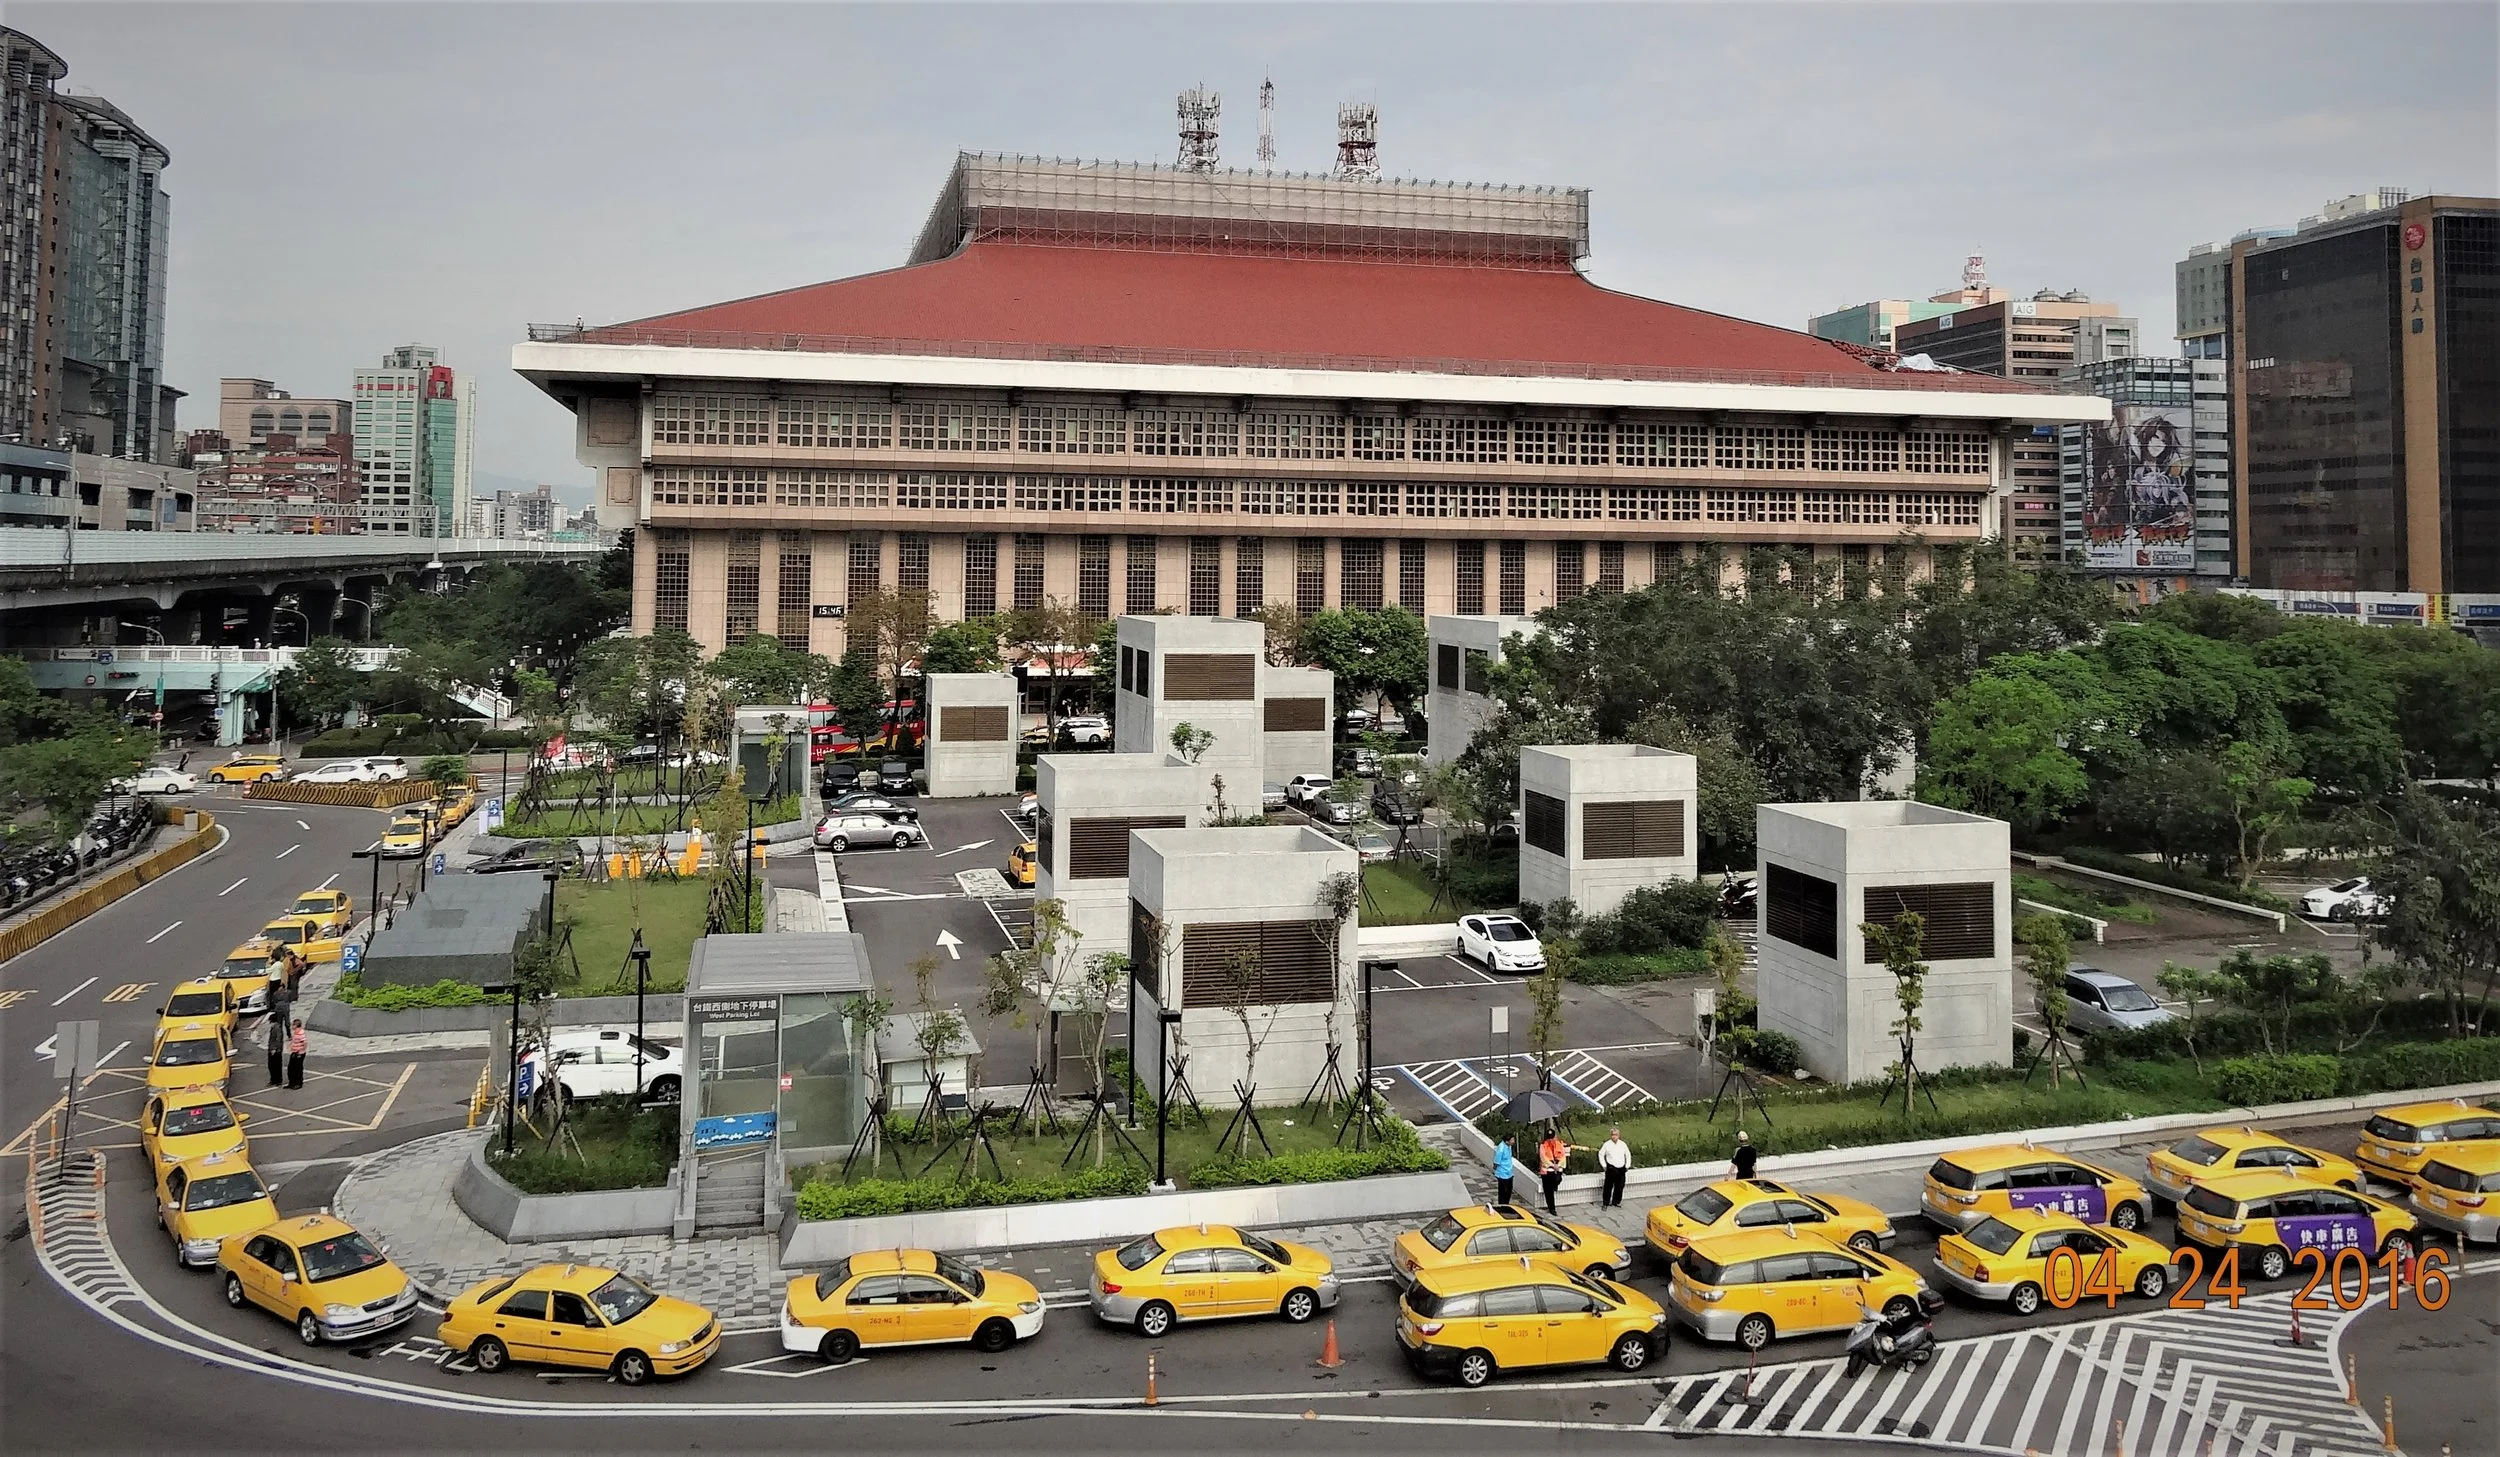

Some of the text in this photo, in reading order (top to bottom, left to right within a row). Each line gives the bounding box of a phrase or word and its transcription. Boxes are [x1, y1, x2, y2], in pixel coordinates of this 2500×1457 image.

[2015, 306, 2034, 315] AIG
[1940, 318, 1951, 328] AIG
[344, 947, 353, 957] P
[519, 1066, 527, 1080] P
[2048, 1198, 2089, 1213] 車廣告
